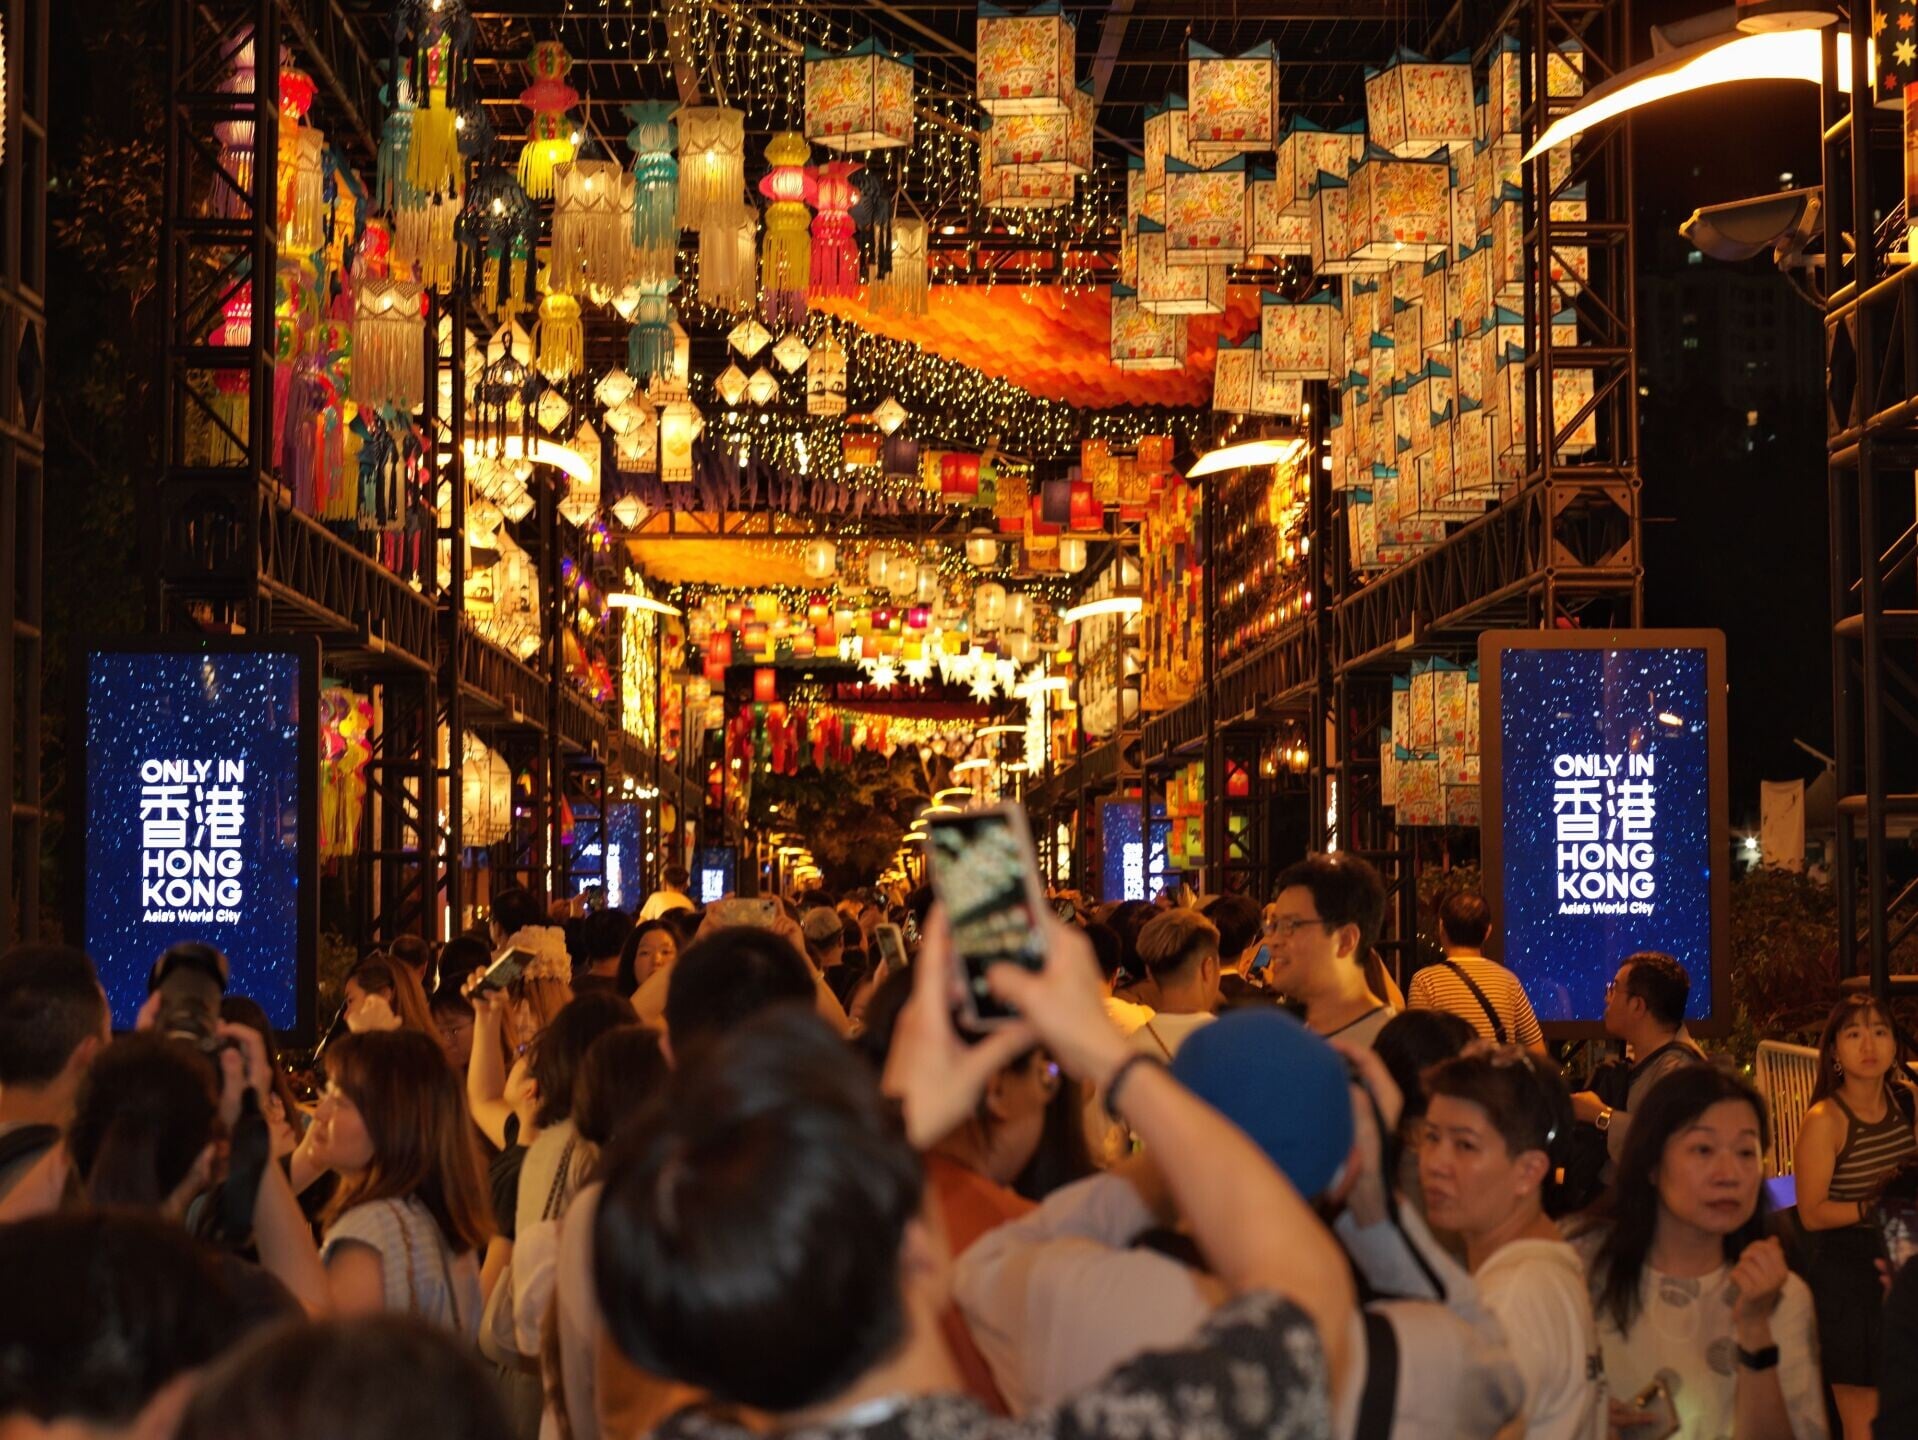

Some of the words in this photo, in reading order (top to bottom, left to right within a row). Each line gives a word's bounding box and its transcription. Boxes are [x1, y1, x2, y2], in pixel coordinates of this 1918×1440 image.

[141, 760, 213, 782] ONLY
[218, 760, 244, 782] IN
[1554, 754, 1622, 776] ONLY
[1628, 754, 1653, 776] IN
[140, 785, 246, 847] 香港
[1553, 780, 1655, 840] 香港
[142, 849, 242, 877] HONG
[1557, 842, 1654, 870] HONG
[142, 878, 242, 907] KONG
[1557, 871, 1655, 899] KONG
[143, 909, 176, 923] Asia's
[178, 909, 213, 923] World
[215, 909, 241, 925] City
[1558, 902, 1591, 915] Asia's
[1592, 901, 1628, 915] World
[1629, 901, 1654, 917] City
